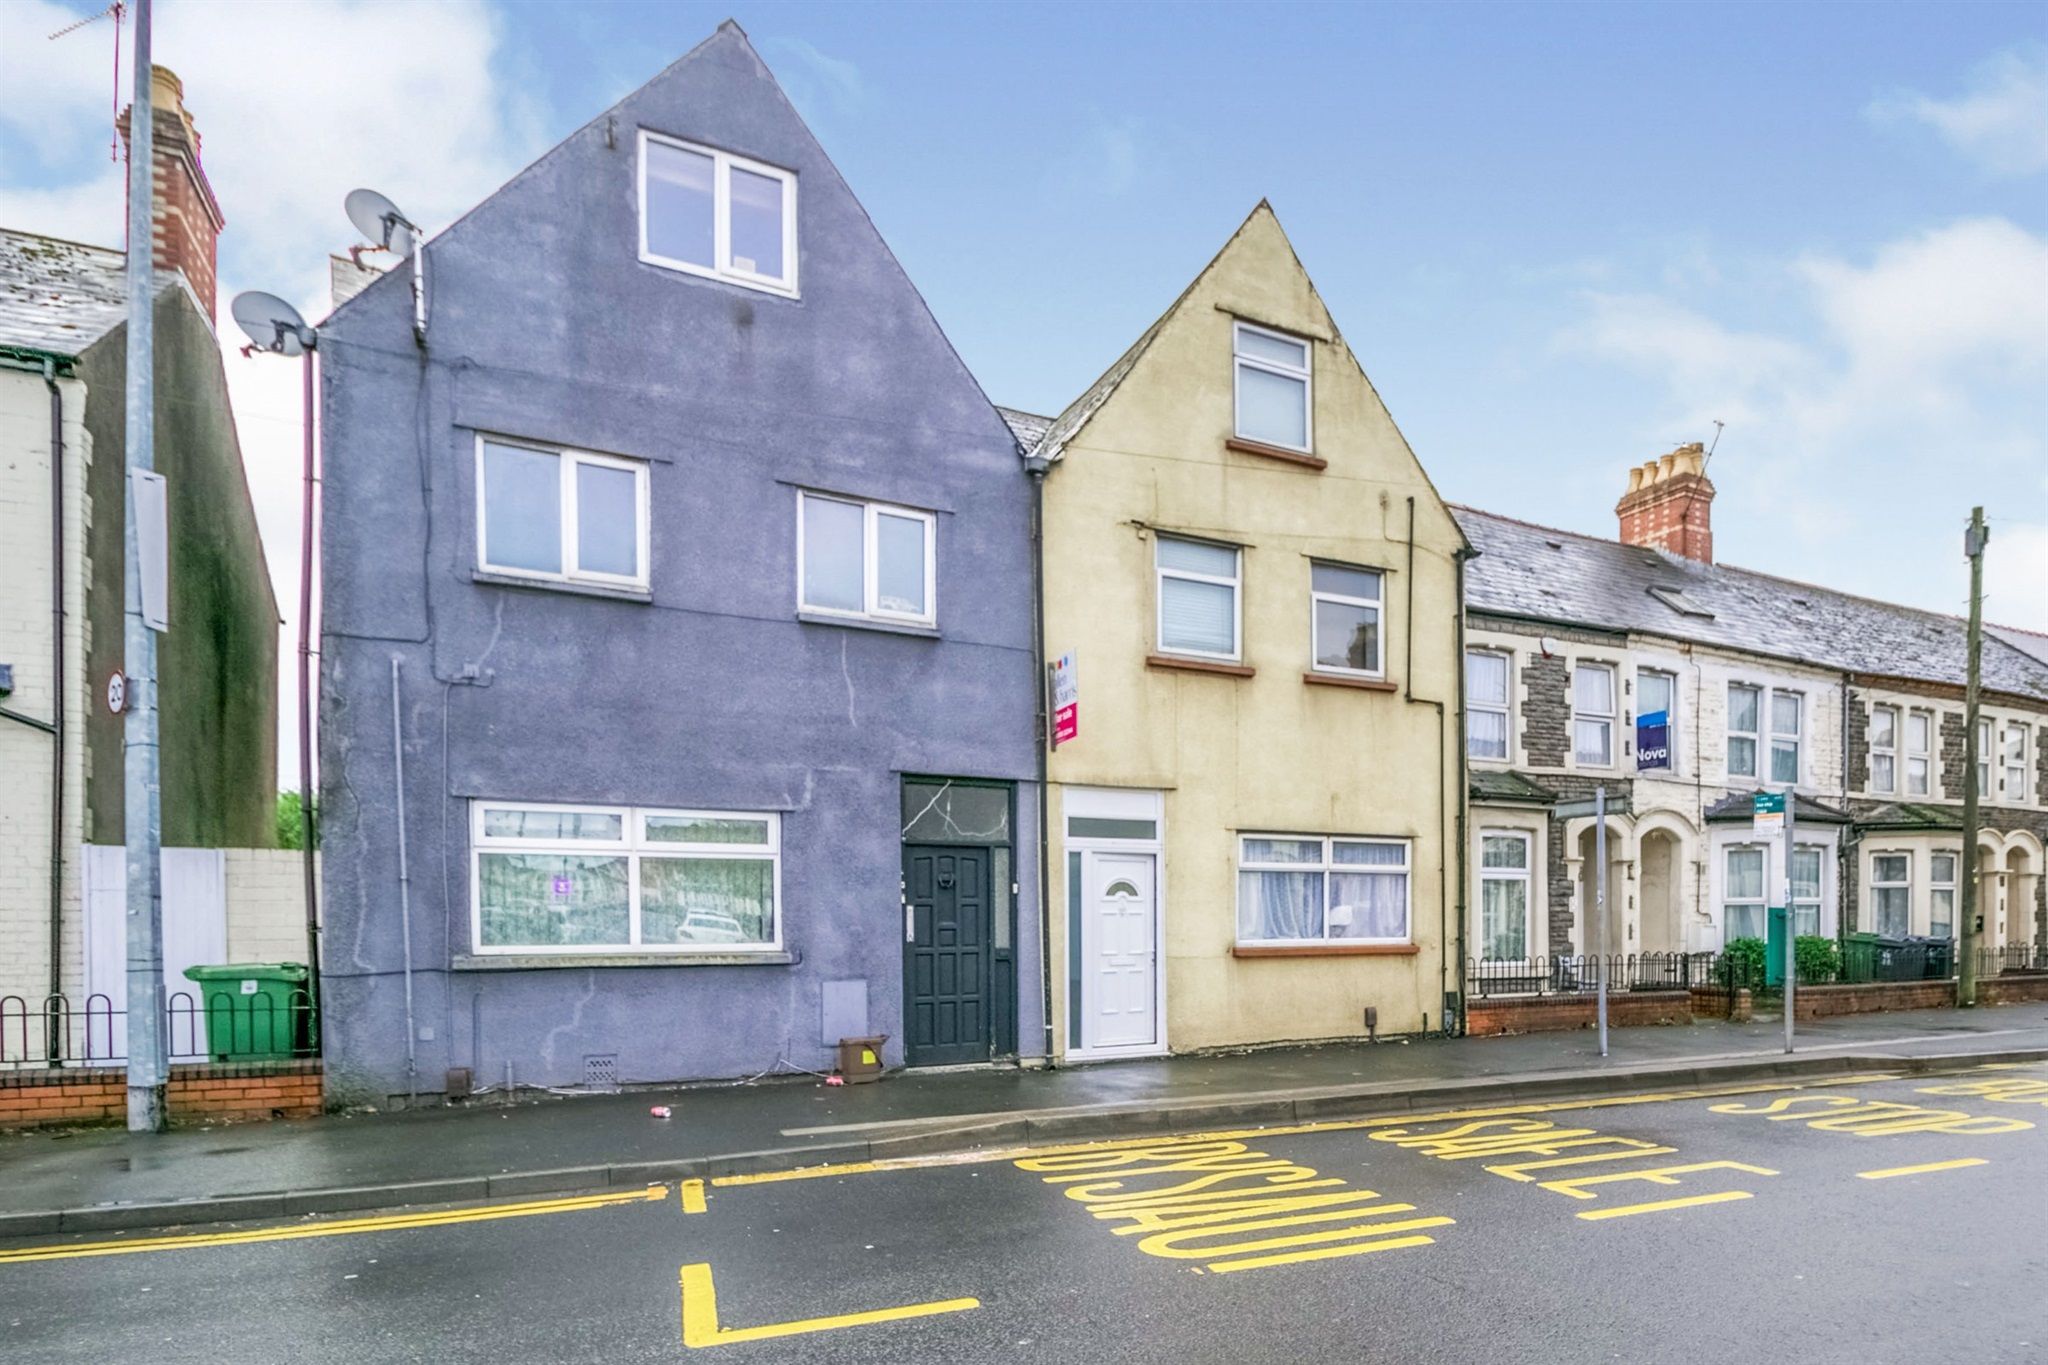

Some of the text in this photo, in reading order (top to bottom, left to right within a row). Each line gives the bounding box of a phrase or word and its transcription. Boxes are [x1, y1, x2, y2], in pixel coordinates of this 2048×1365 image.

[1637, 748, 1667, 761] Nova
[1707, 1094, 2036, 1136] STOP
[1368, 1117, 1782, 1200] SAFLE
[1013, 1141, 1457, 1260] BYSIAU
